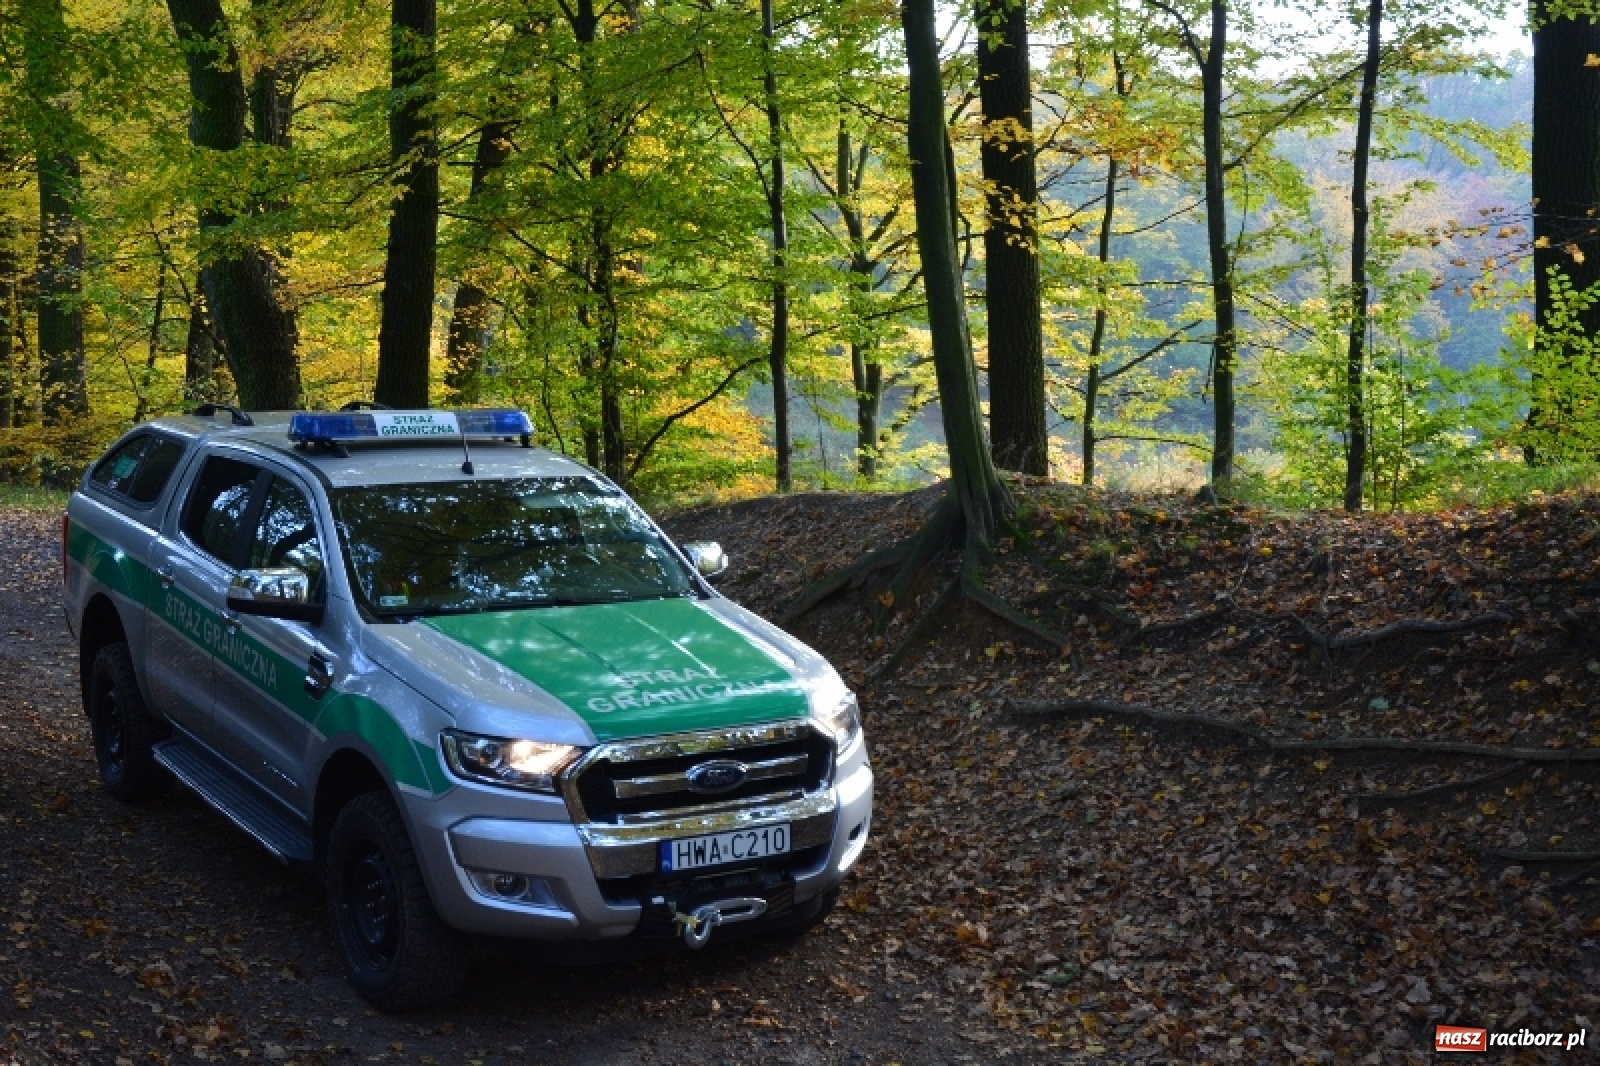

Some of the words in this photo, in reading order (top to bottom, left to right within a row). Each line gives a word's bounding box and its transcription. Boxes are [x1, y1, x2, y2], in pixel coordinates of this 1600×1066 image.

[382, 424, 455, 436] GRANICZNA
[203, 618, 278, 690] GRANICZNA
[677, 837, 722, 867] HWA
[731, 827, 785, 859] C210
